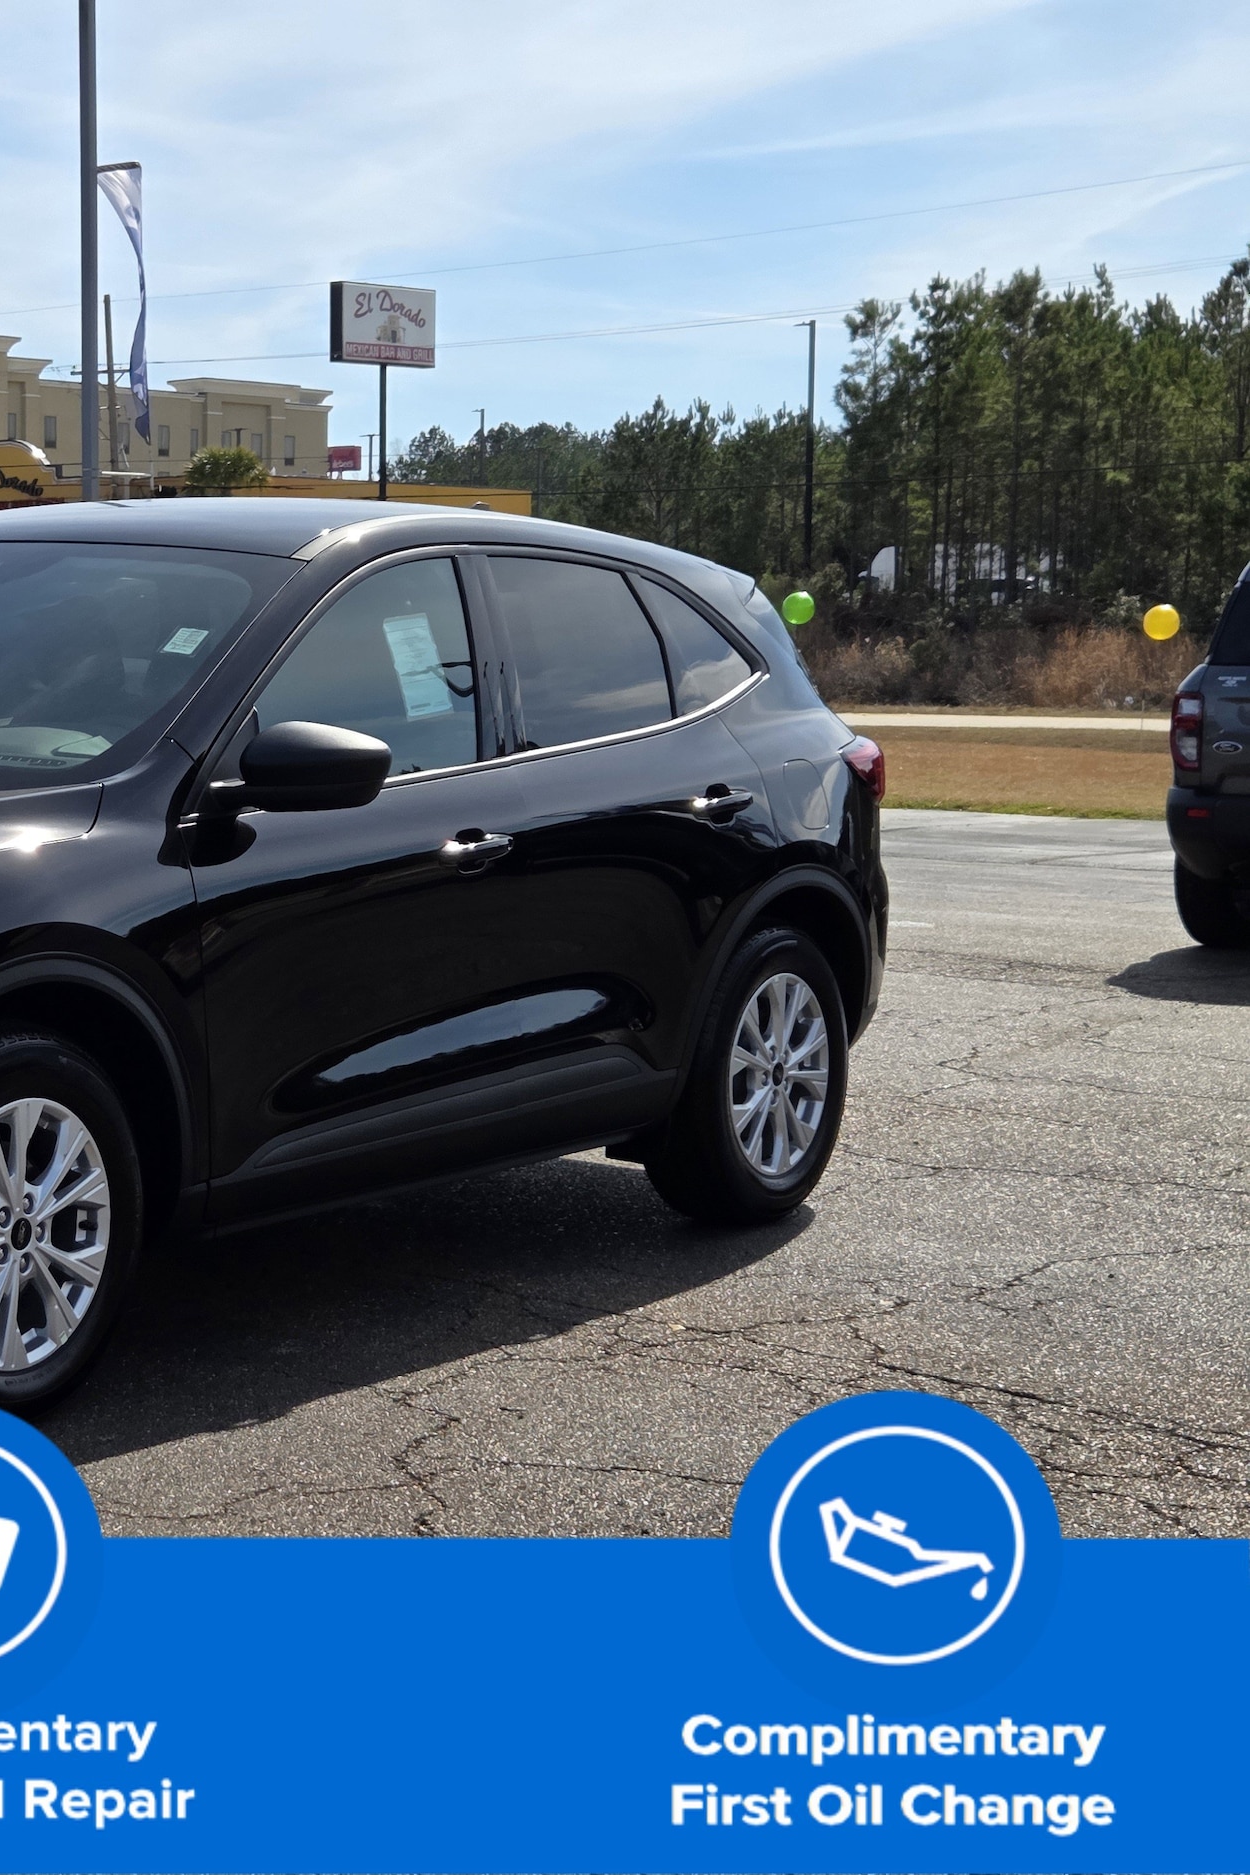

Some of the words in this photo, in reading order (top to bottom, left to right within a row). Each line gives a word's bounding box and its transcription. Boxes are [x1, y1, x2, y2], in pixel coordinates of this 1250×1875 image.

[353, 292, 374, 319] El
[376, 289, 427, 329] Dorado
[346, 343, 379, 357] MEXICAN
[380, 346, 395, 358] BAR
[396, 347, 411, 359] AND
[412, 348, 434, 361] GRILL
